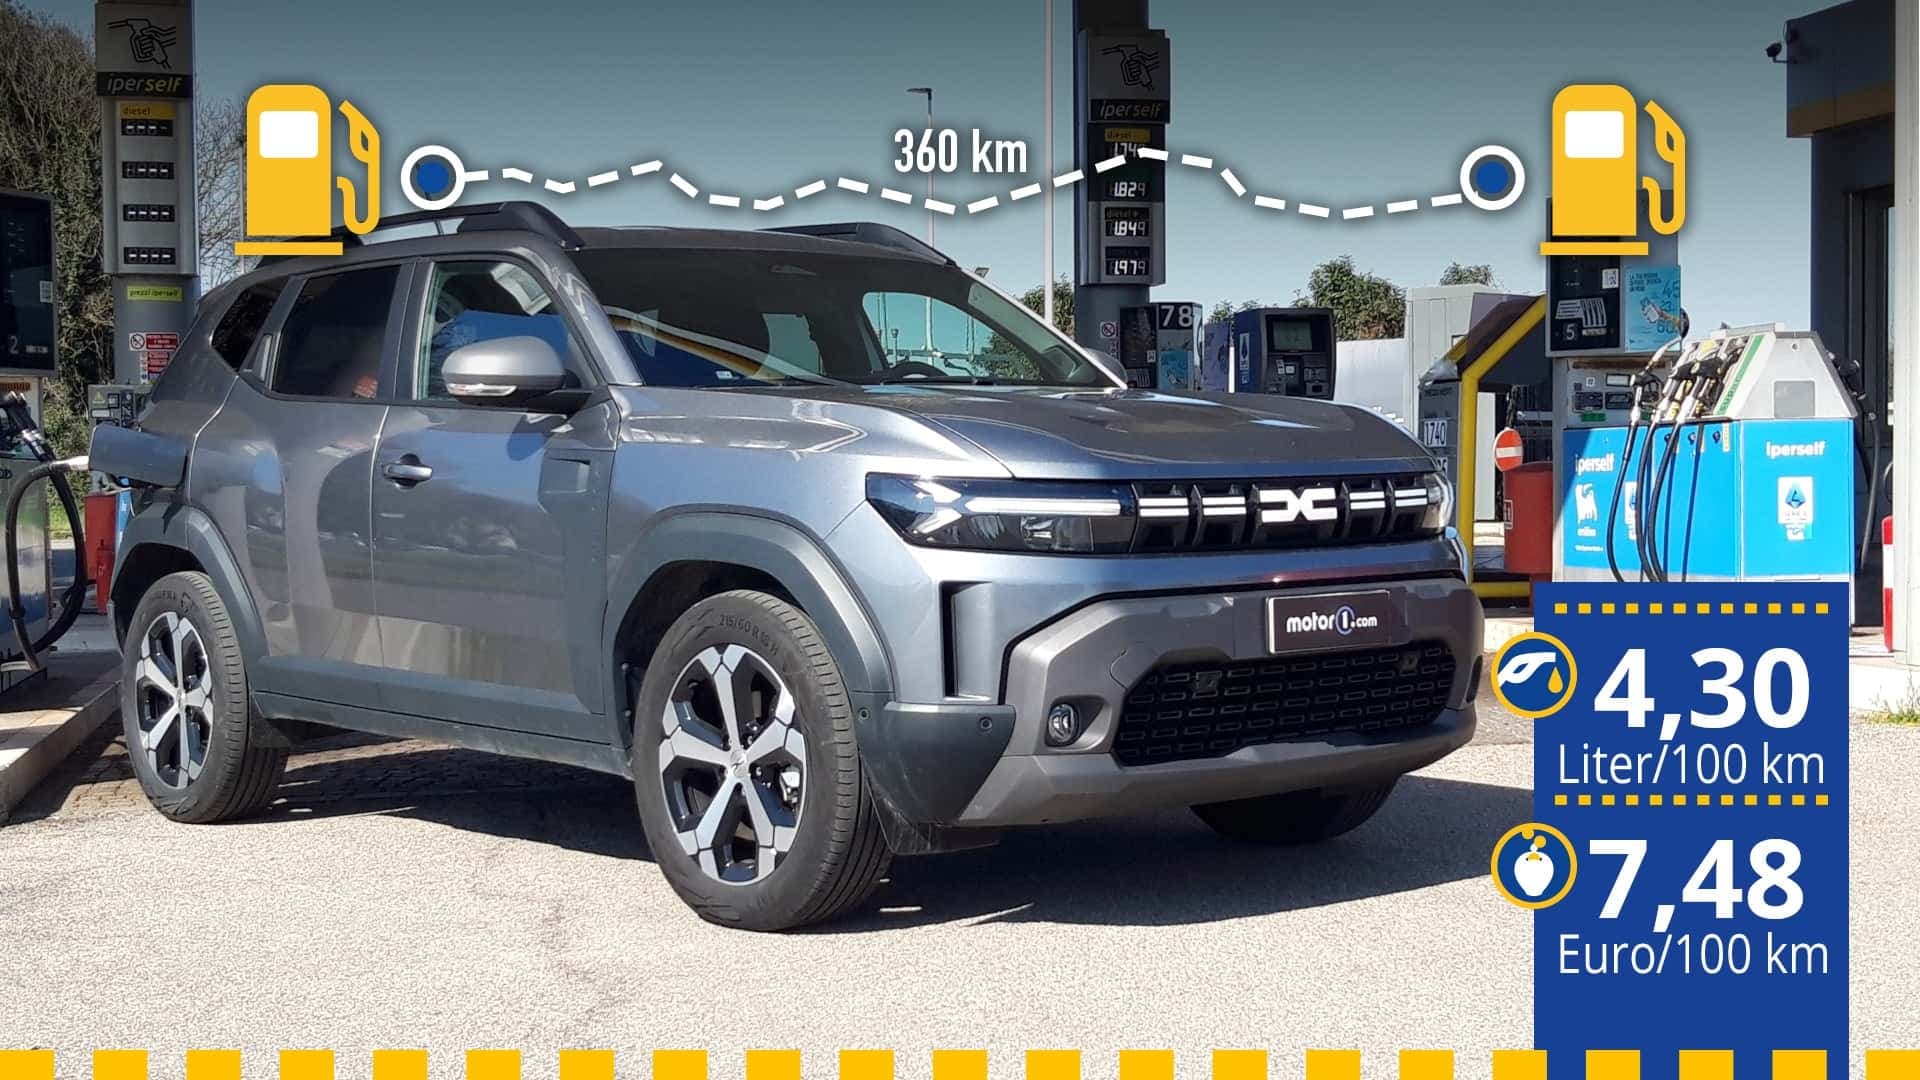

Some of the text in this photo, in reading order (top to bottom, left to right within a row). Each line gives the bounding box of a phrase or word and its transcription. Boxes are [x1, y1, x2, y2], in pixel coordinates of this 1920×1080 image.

[107, 73, 183, 94] iperself
[1100, 101, 1161, 119] iperself
[1565, 323, 1576, 340] 5
[8, 335, 19, 354] 2
[1766, 440, 1825, 460] iperself
[1575, 453, 1615, 476] iperself
[1286, 607, 1378, 634] motor1.com
